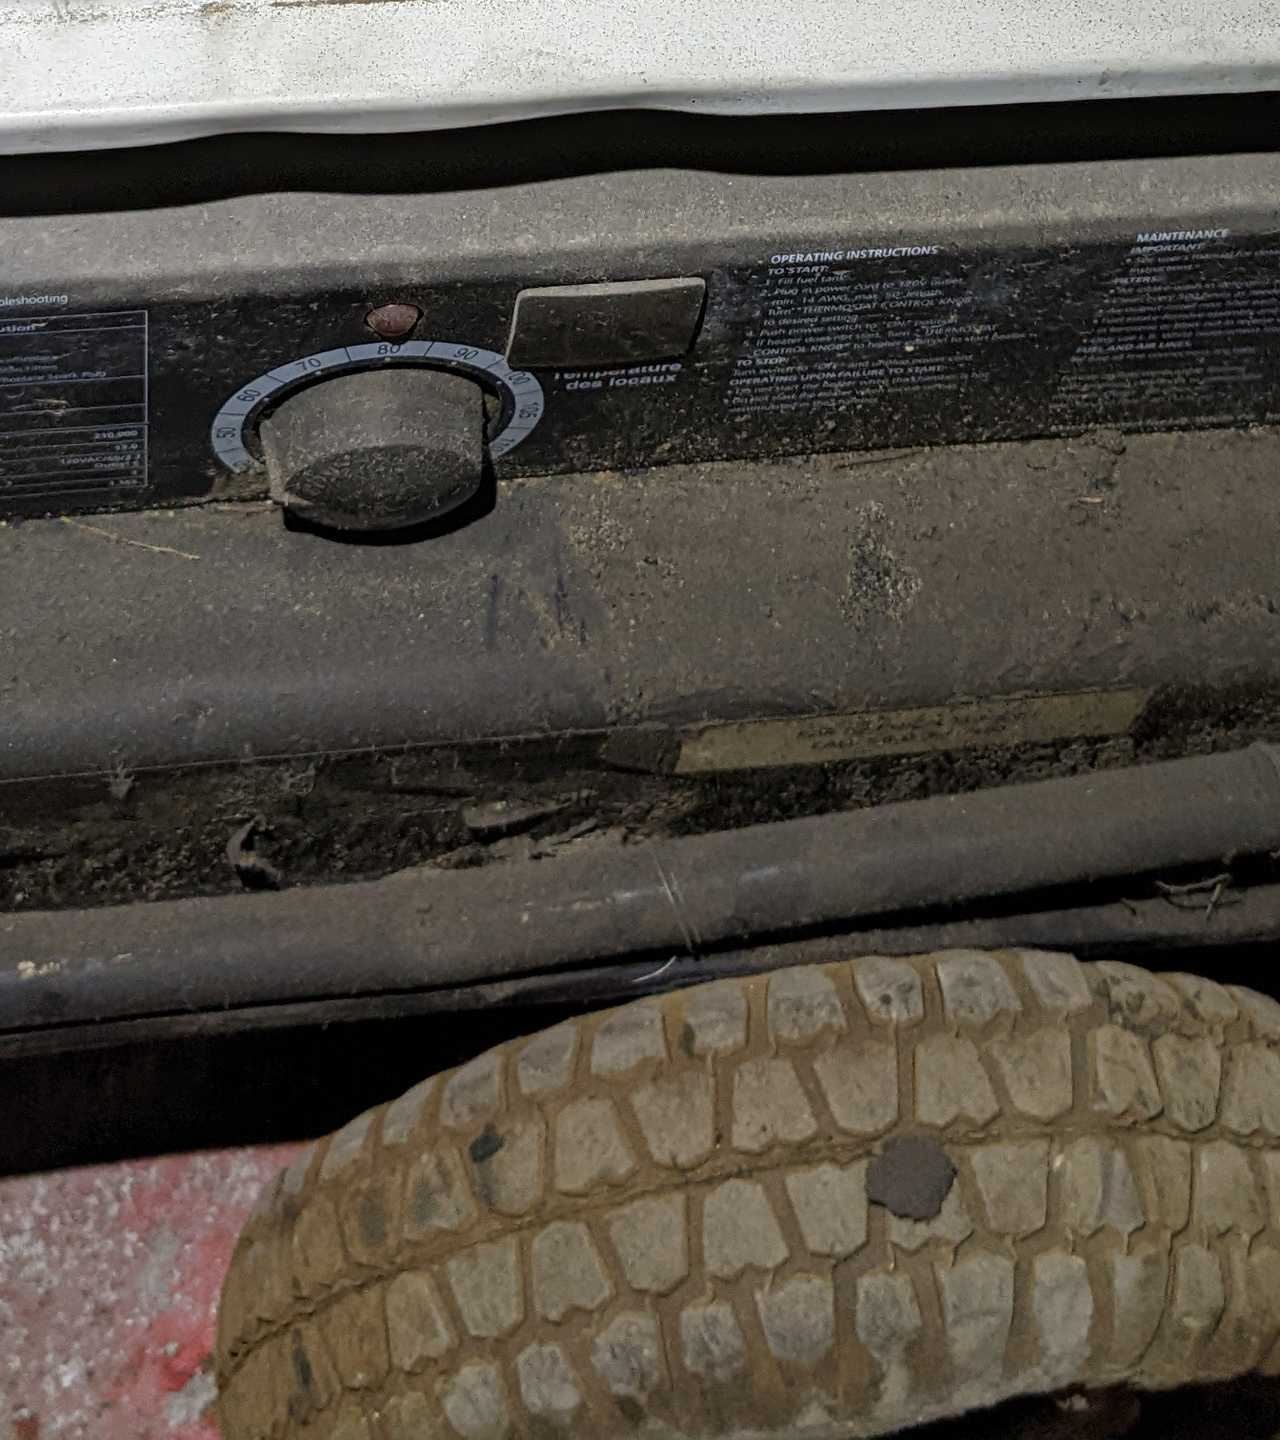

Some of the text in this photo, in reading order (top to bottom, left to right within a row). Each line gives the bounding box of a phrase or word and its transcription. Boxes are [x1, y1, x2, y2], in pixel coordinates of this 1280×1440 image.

[1136, 227, 1232, 243] MAINTENANCE
[770, 245, 941, 265] OPERATING INSTRUCTIONS
[767, 266, 785, 276] TO
[376, 342, 402, 356] 80
[452, 346, 480, 361] 90
[295, 357, 322, 372] 70
[503, 370, 531, 386] 100
[565, 374, 677, 391] des locaux
[236, 388, 262, 403] 60
[519, 401, 539, 419] 105
[215, 426, 237, 439] 50
